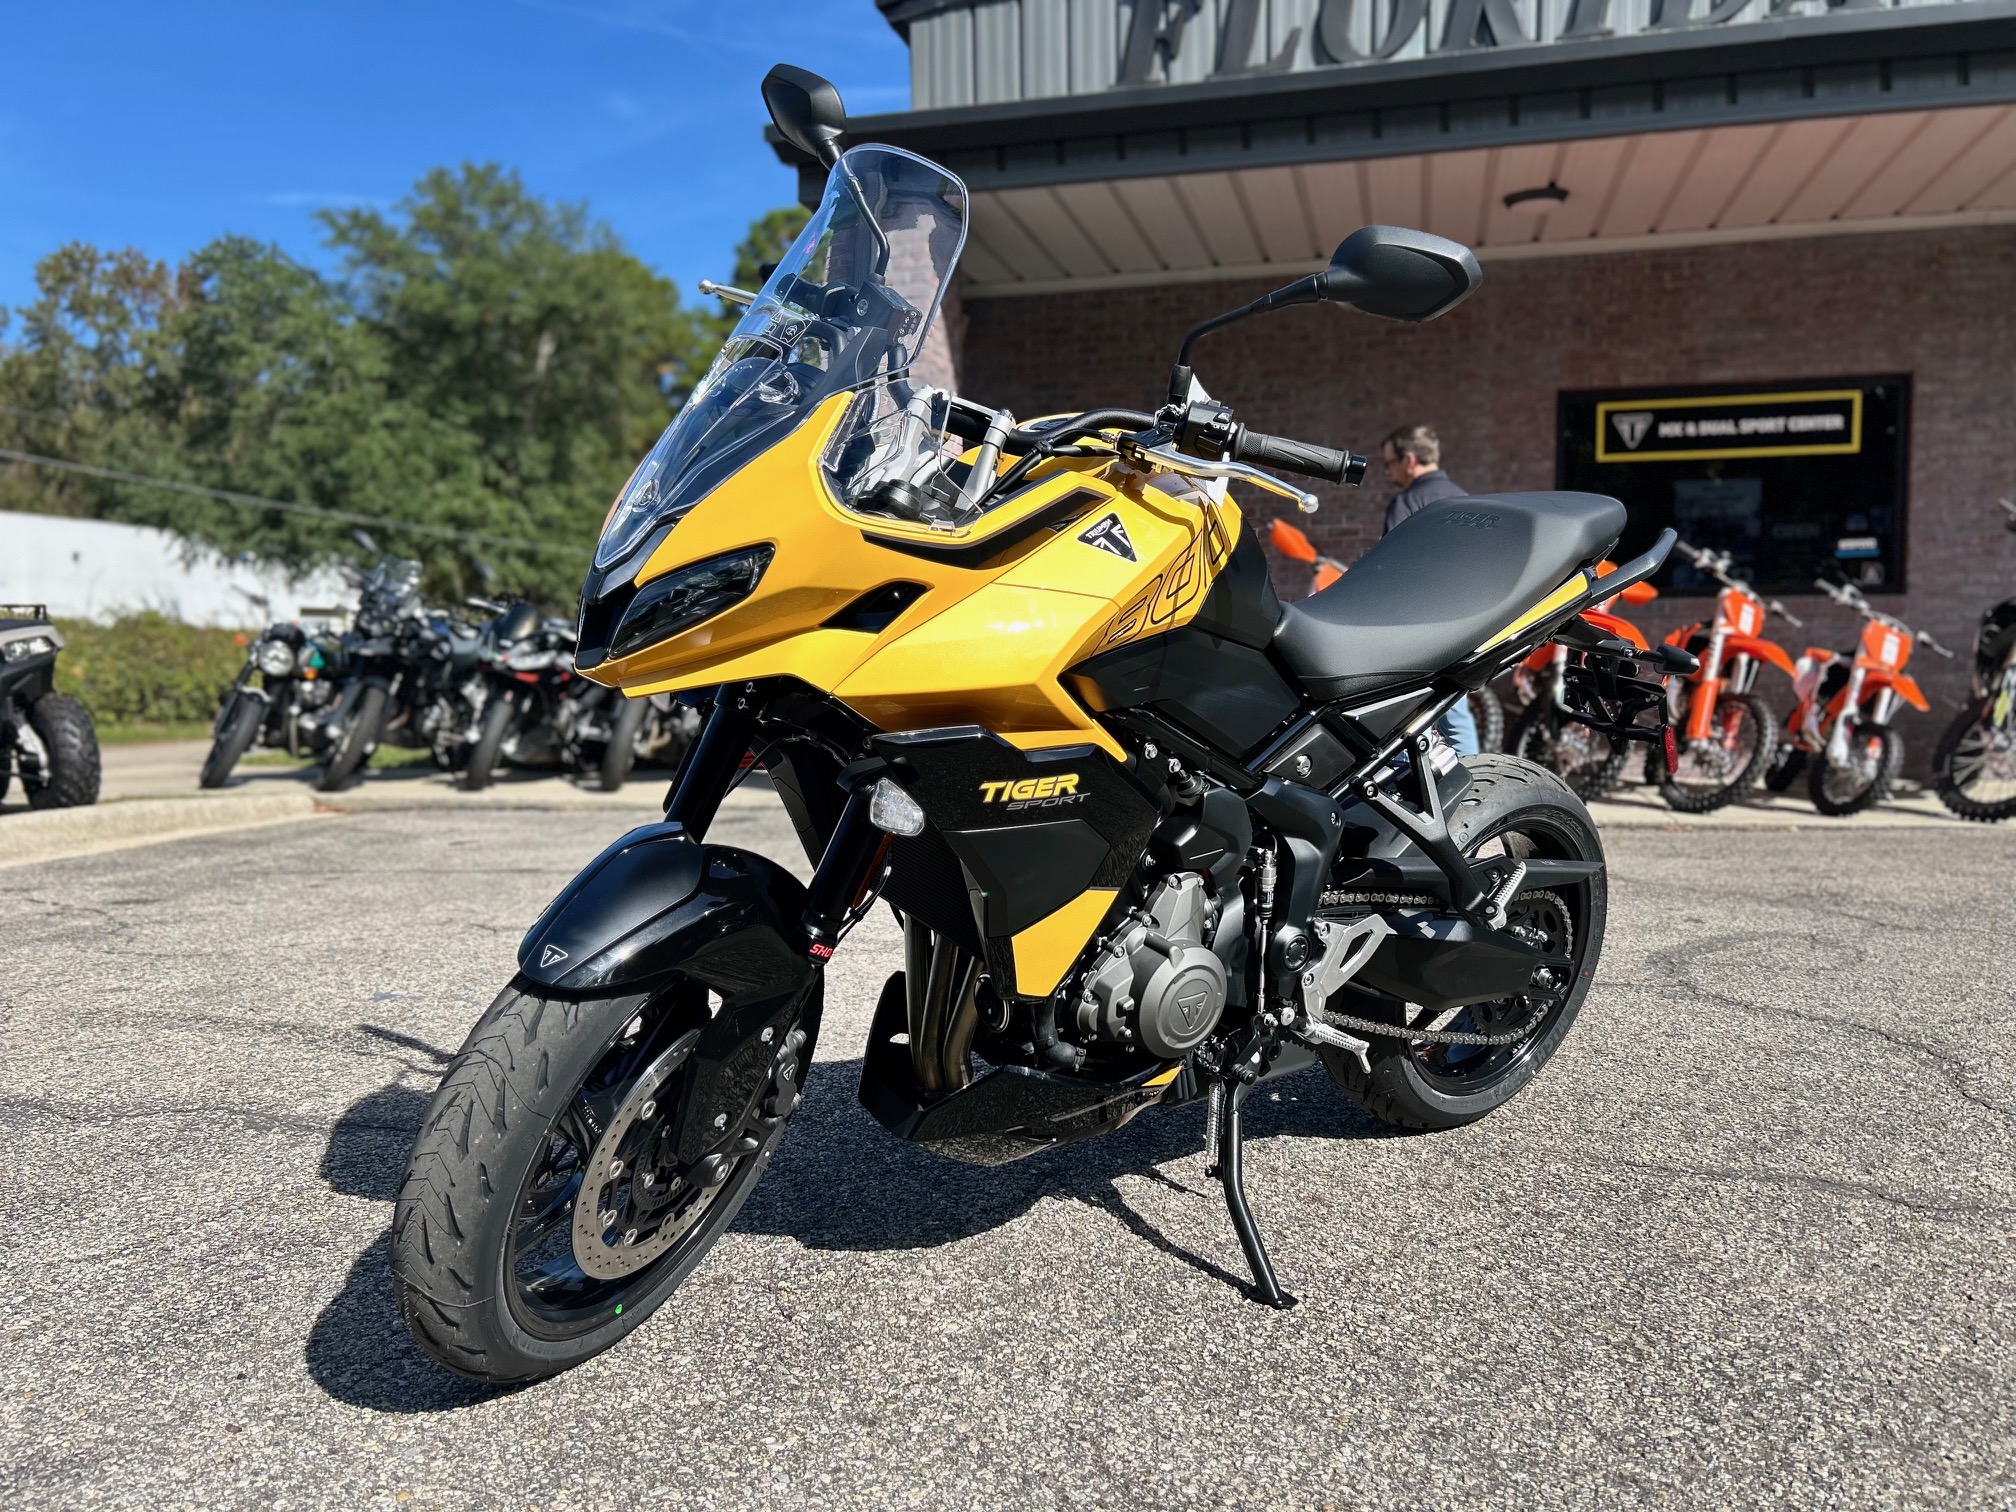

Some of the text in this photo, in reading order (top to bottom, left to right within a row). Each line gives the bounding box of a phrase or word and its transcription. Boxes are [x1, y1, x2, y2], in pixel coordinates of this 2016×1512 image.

[1698, 419, 1738, 436] DUAL
[1738, 416, 1787, 434] SPORT
[1787, 414, 1846, 432] CENTER
[1085, 518, 1113, 539] TRIUMPH
[979, 773, 1079, 803] TIGER
[1006, 793, 1091, 811] SPORT
